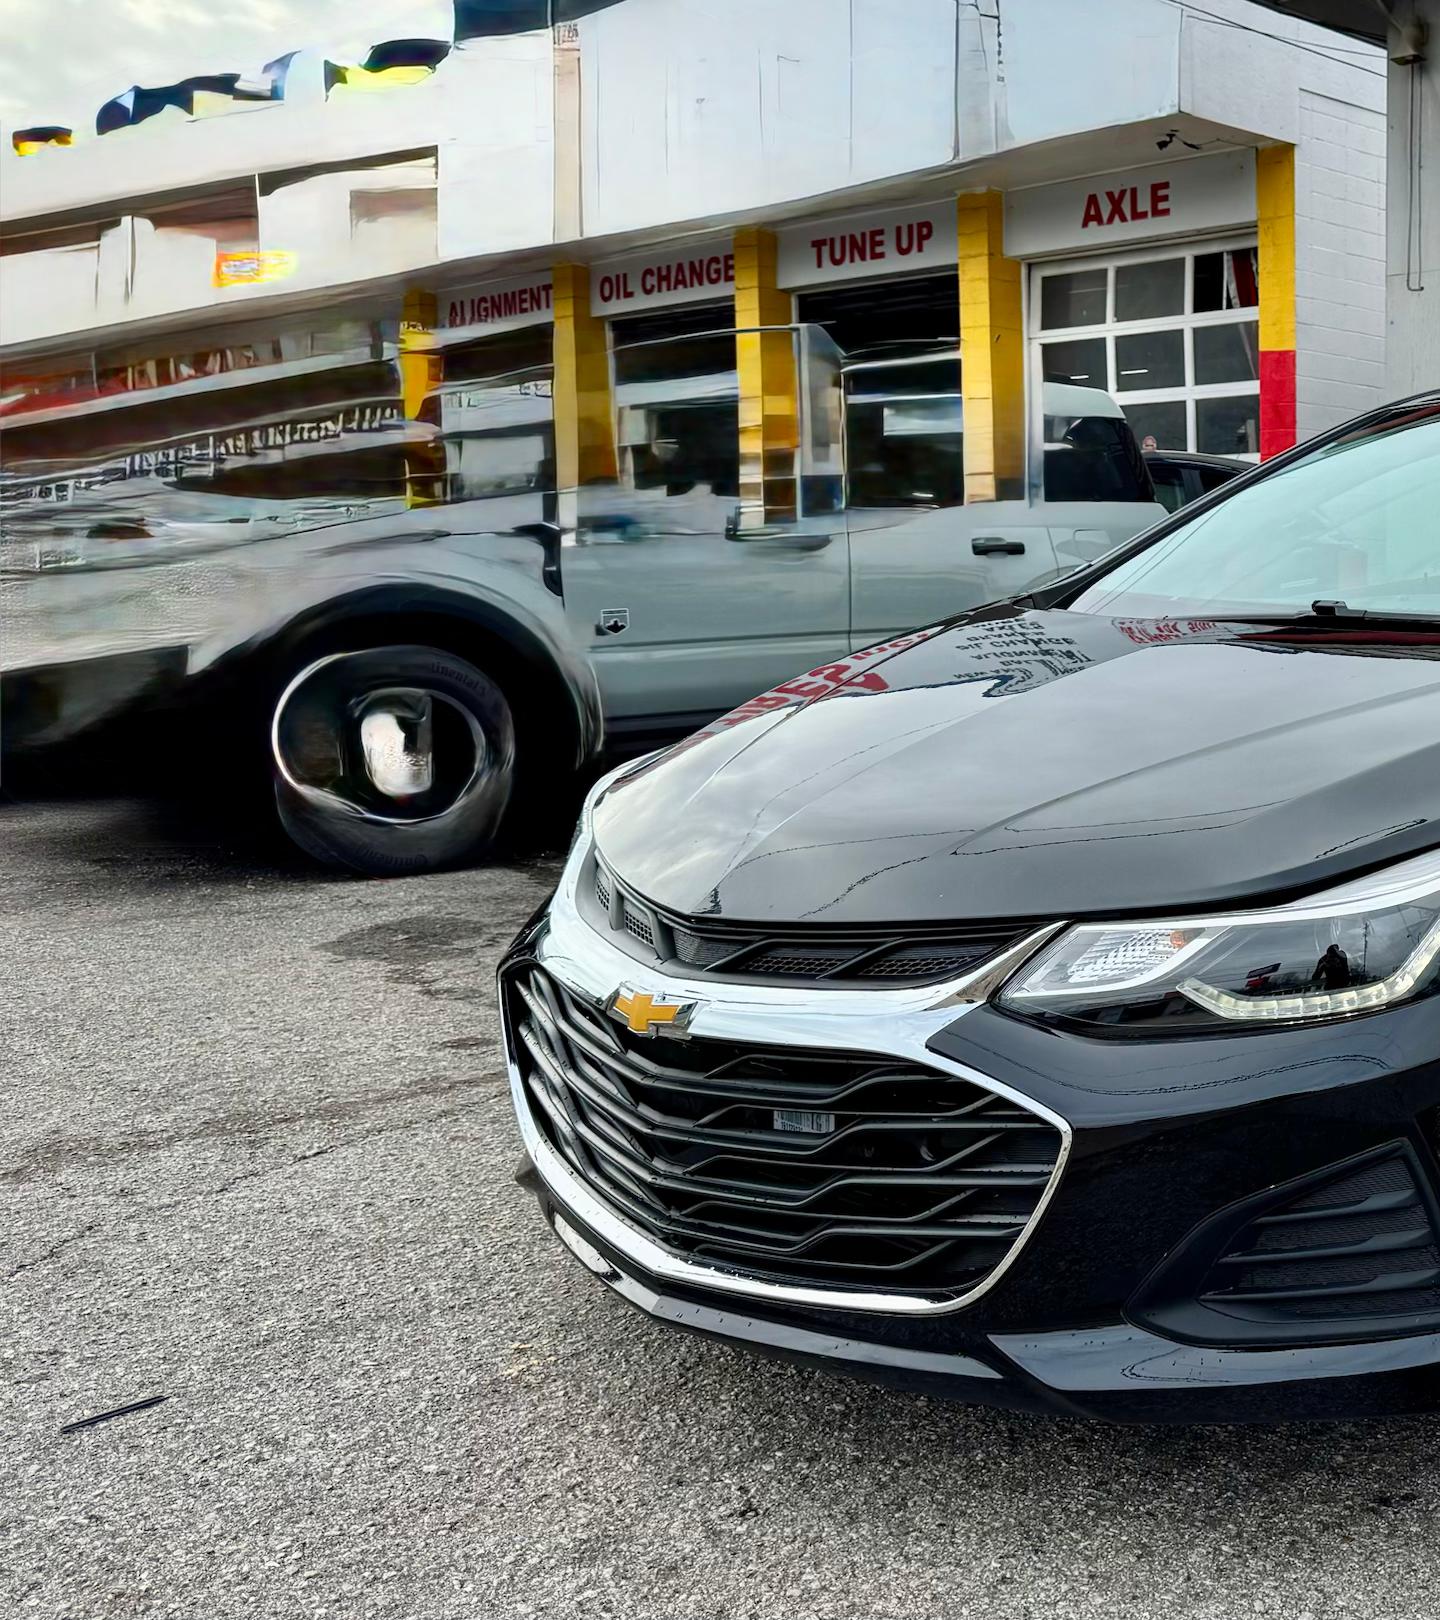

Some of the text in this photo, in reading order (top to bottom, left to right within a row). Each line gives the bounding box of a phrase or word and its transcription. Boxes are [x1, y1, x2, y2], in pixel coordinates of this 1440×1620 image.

[1082, 181, 1172, 229] AXLE
[811, 220, 934, 269] TUNE UP
[600, 254, 735, 303] OIL CHANGE
